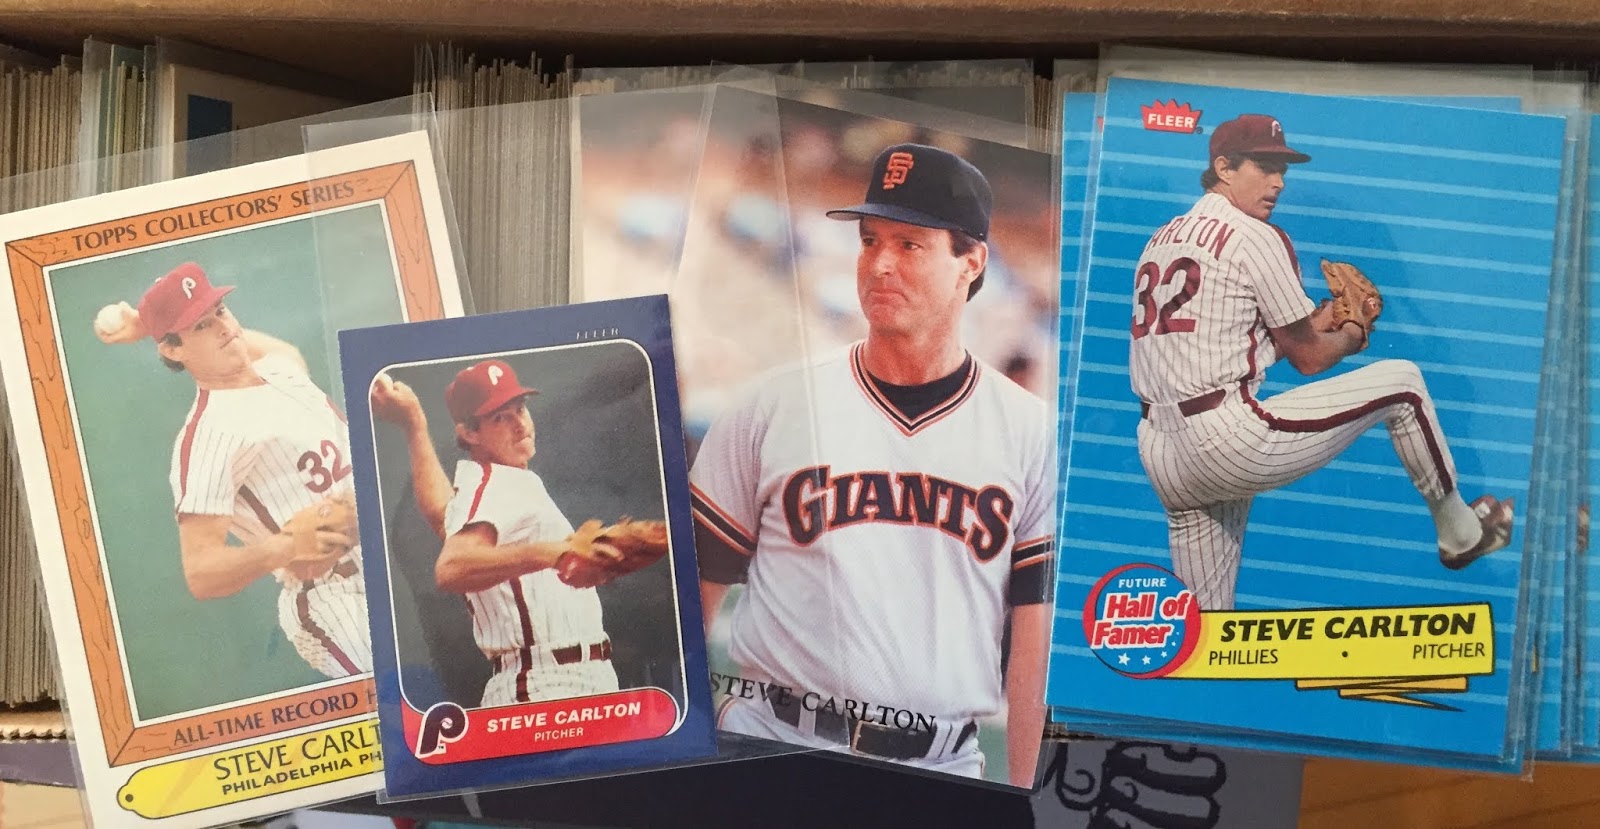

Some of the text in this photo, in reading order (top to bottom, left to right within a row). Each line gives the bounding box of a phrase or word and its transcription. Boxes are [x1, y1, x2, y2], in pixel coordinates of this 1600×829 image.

[1147, 114, 1195, 128] FLEER
[72, 180, 356, 252] TOPPS COLLECTORS' SERIES
[1131, 256, 1201, 341] 32
[297, 440, 352, 493] 32
[782, 465, 1014, 564] GIANTS
[1119, 578, 1167, 588] FUTURE
[1105, 591, 1191, 619] Hall of
[1092, 621, 1173, 648] Famer
[1220, 612, 1476, 643] STEVE CARLTON
[1208, 649, 1279, 666] PHILLIES
[1412, 643, 1486, 660] PITCHER
[487, 702, 641, 733] STEVE CARLTON
[710, 672, 936, 733] STEVE CARLTON
[174, 712, 265, 746] ALL-TIME
[272, 691, 359, 725] RECORD
[534, 727, 584, 742] PITCHER
[213, 745, 292, 781] STEVE
[222, 757, 353, 795] PHILADELPHIA
